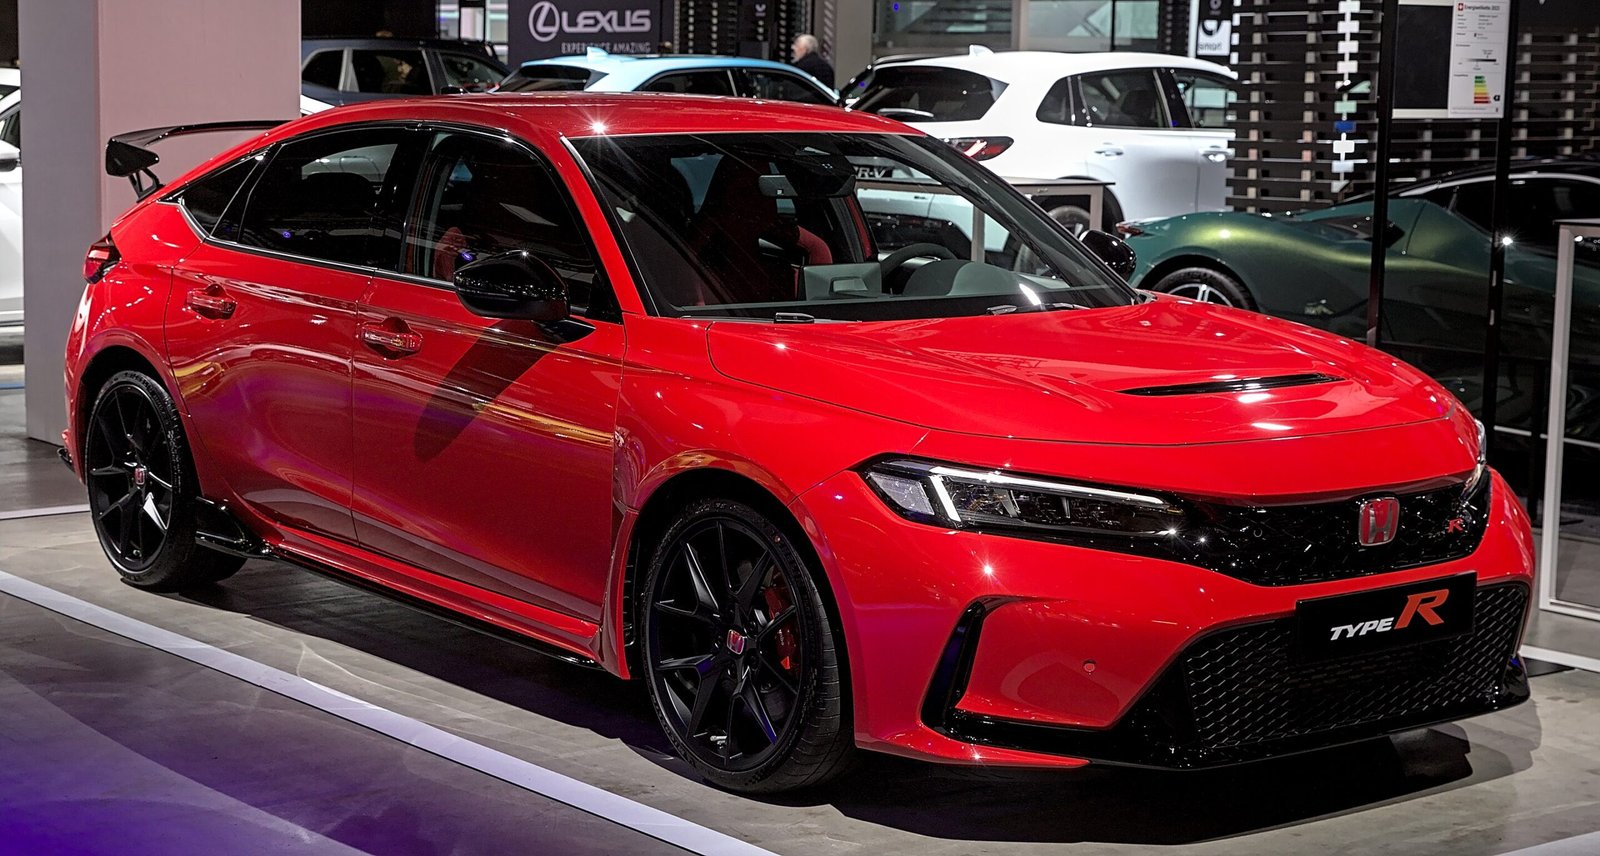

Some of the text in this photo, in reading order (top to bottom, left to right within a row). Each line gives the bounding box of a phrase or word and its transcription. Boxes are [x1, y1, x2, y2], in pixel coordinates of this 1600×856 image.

[561, 10, 651, 33] LEXUS
[612, 42, 651, 53] AMAZING
[854, 166, 887, 178] R-V
[1330, 588, 1450, 641] TYPE R
